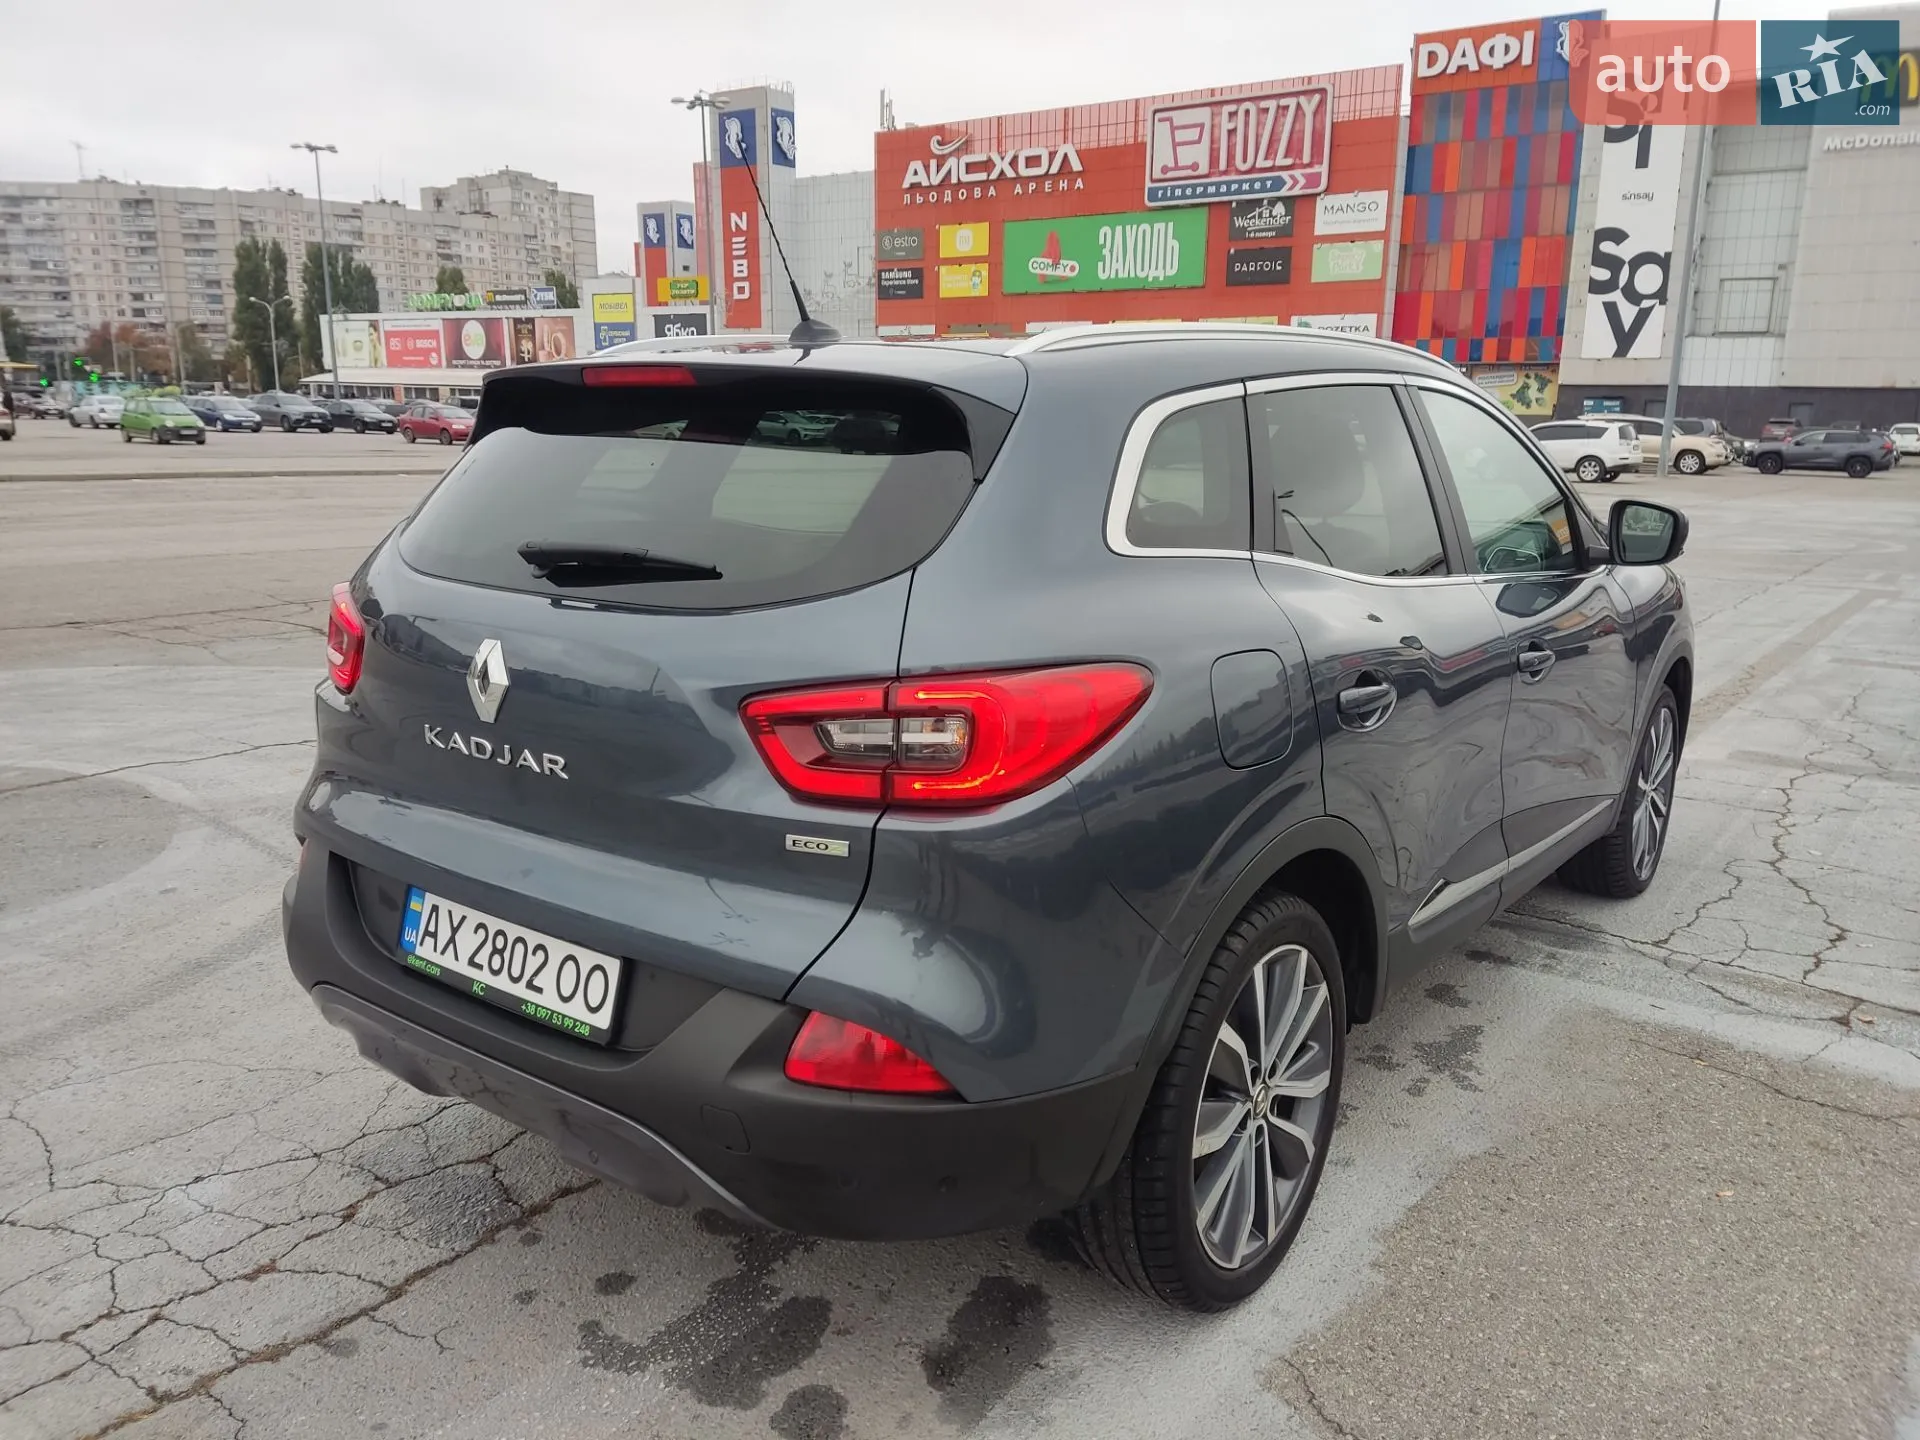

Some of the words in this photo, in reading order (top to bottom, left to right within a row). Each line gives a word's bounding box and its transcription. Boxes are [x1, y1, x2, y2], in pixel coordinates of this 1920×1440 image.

[1219, 93, 1322, 172] FOZZY
[904, 186, 997, 205] ЛЬОДОВА
[1014, 178, 1085, 195] АРЕНА
[1621, 190, 1655, 202] sinsay
[1323, 201, 1379, 216] MANGO
[1233, 209, 1292, 228] Weekender
[894, 235, 918, 247] estro
[1097, 222, 1180, 281] ЗАХОДЬ
[881, 270, 912, 280] SAMSUNG
[1031, 260, 1069, 273] COMFY
[423, 724, 569, 780] KADJAR
[404, 926, 416, 944] UA
